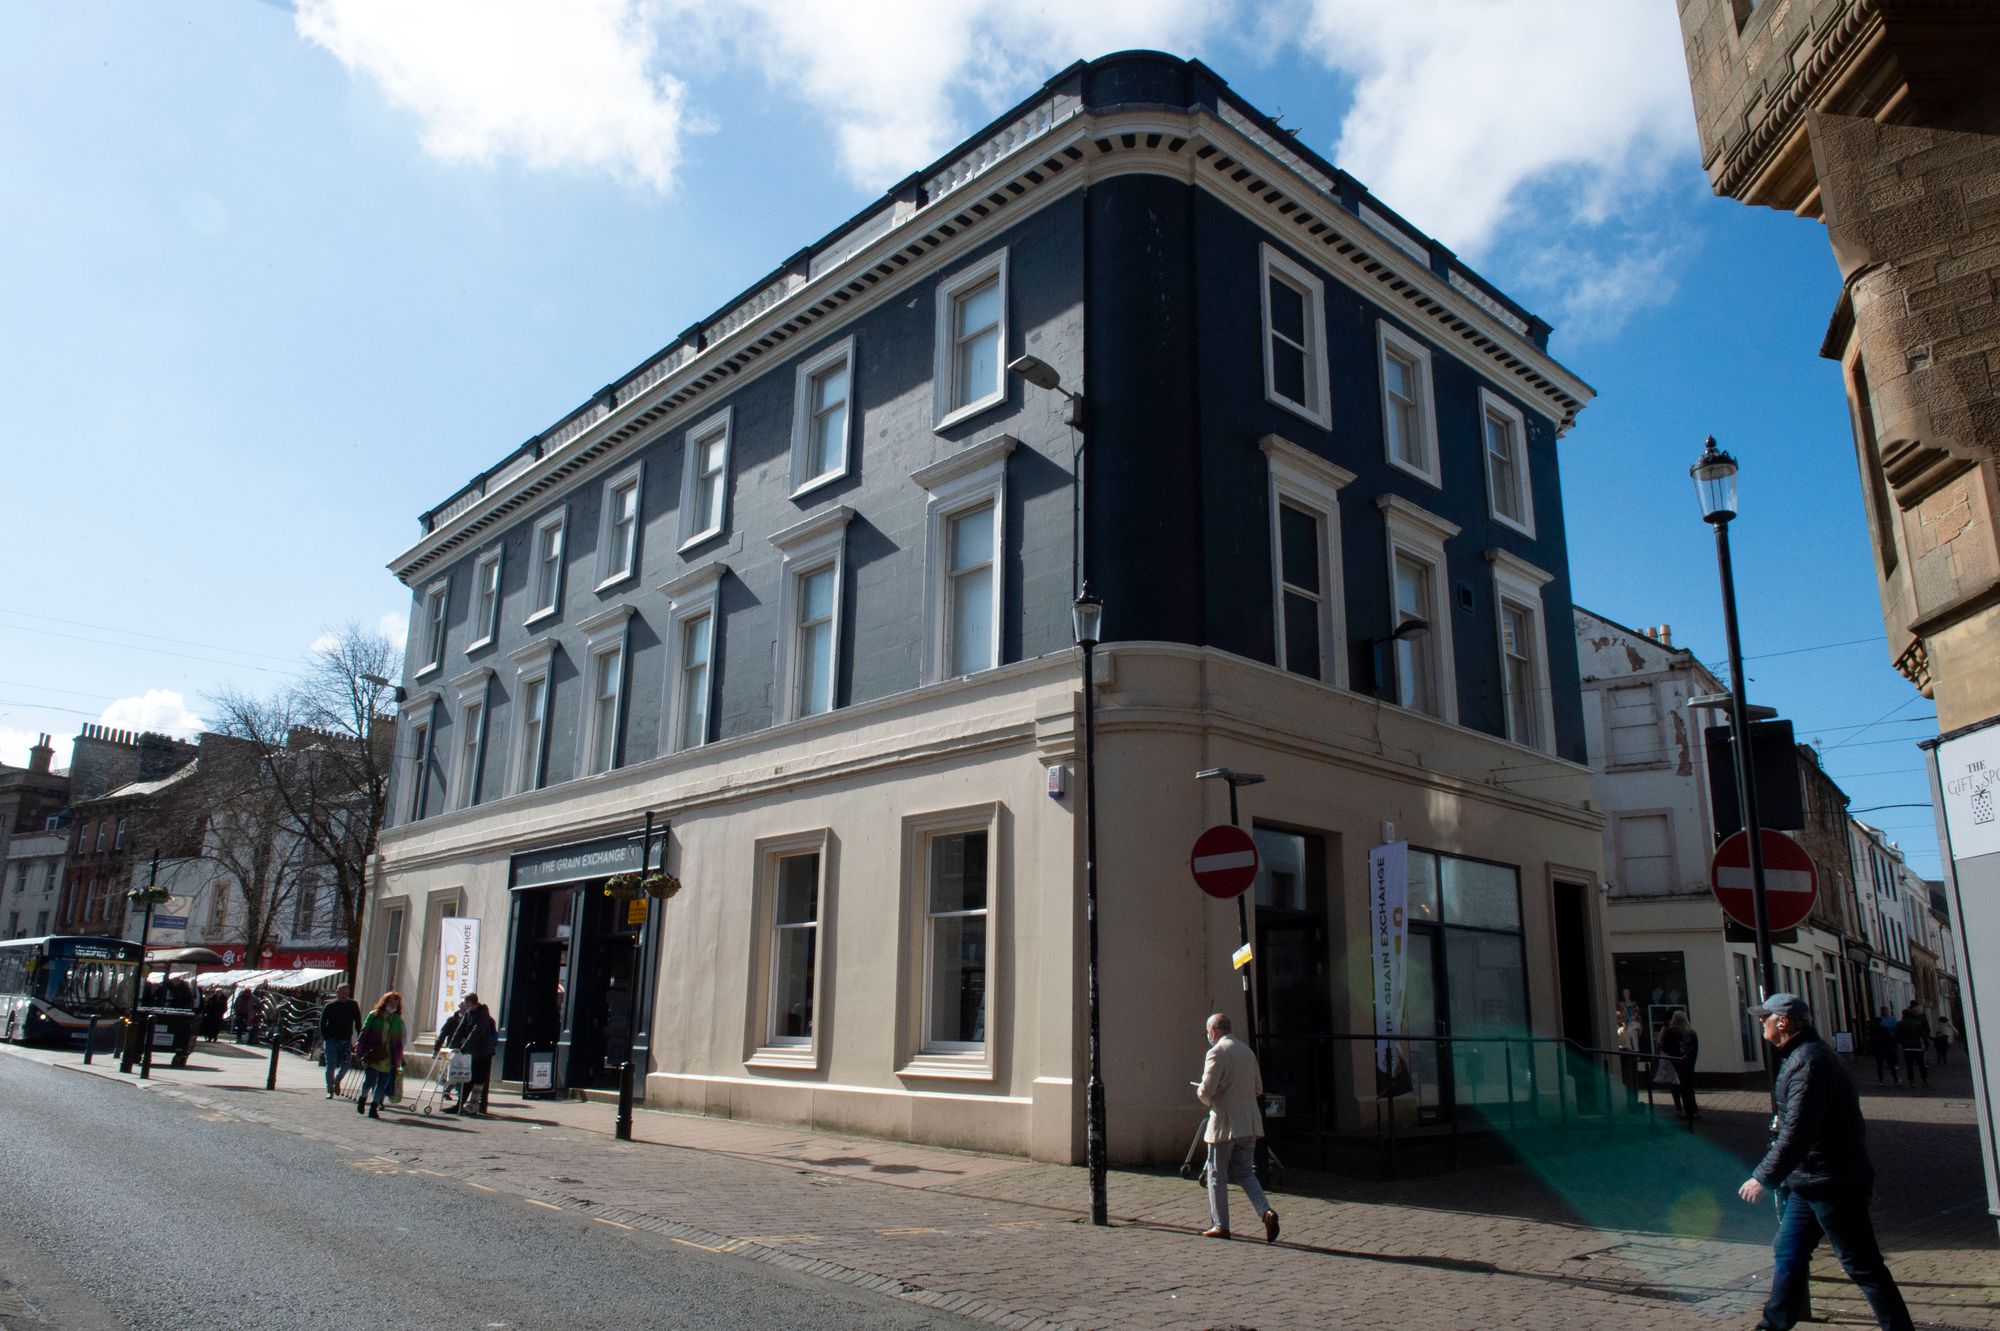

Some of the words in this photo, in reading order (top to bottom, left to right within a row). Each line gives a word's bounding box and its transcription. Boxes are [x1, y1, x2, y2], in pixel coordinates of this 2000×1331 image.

[1966, 760, 1985, 773] THE
[1948, 775, 1973, 796] GIFT
[541, 860, 556, 873] THE
[557, 857, 581, 871] GRAIN
[582, 847, 626, 867] EXCHANGE
[1377, 856, 1389, 947] EXCHANGE
[303, 955, 337, 968] Santander
[1384, 952, 1392, 1006] GRAIN
